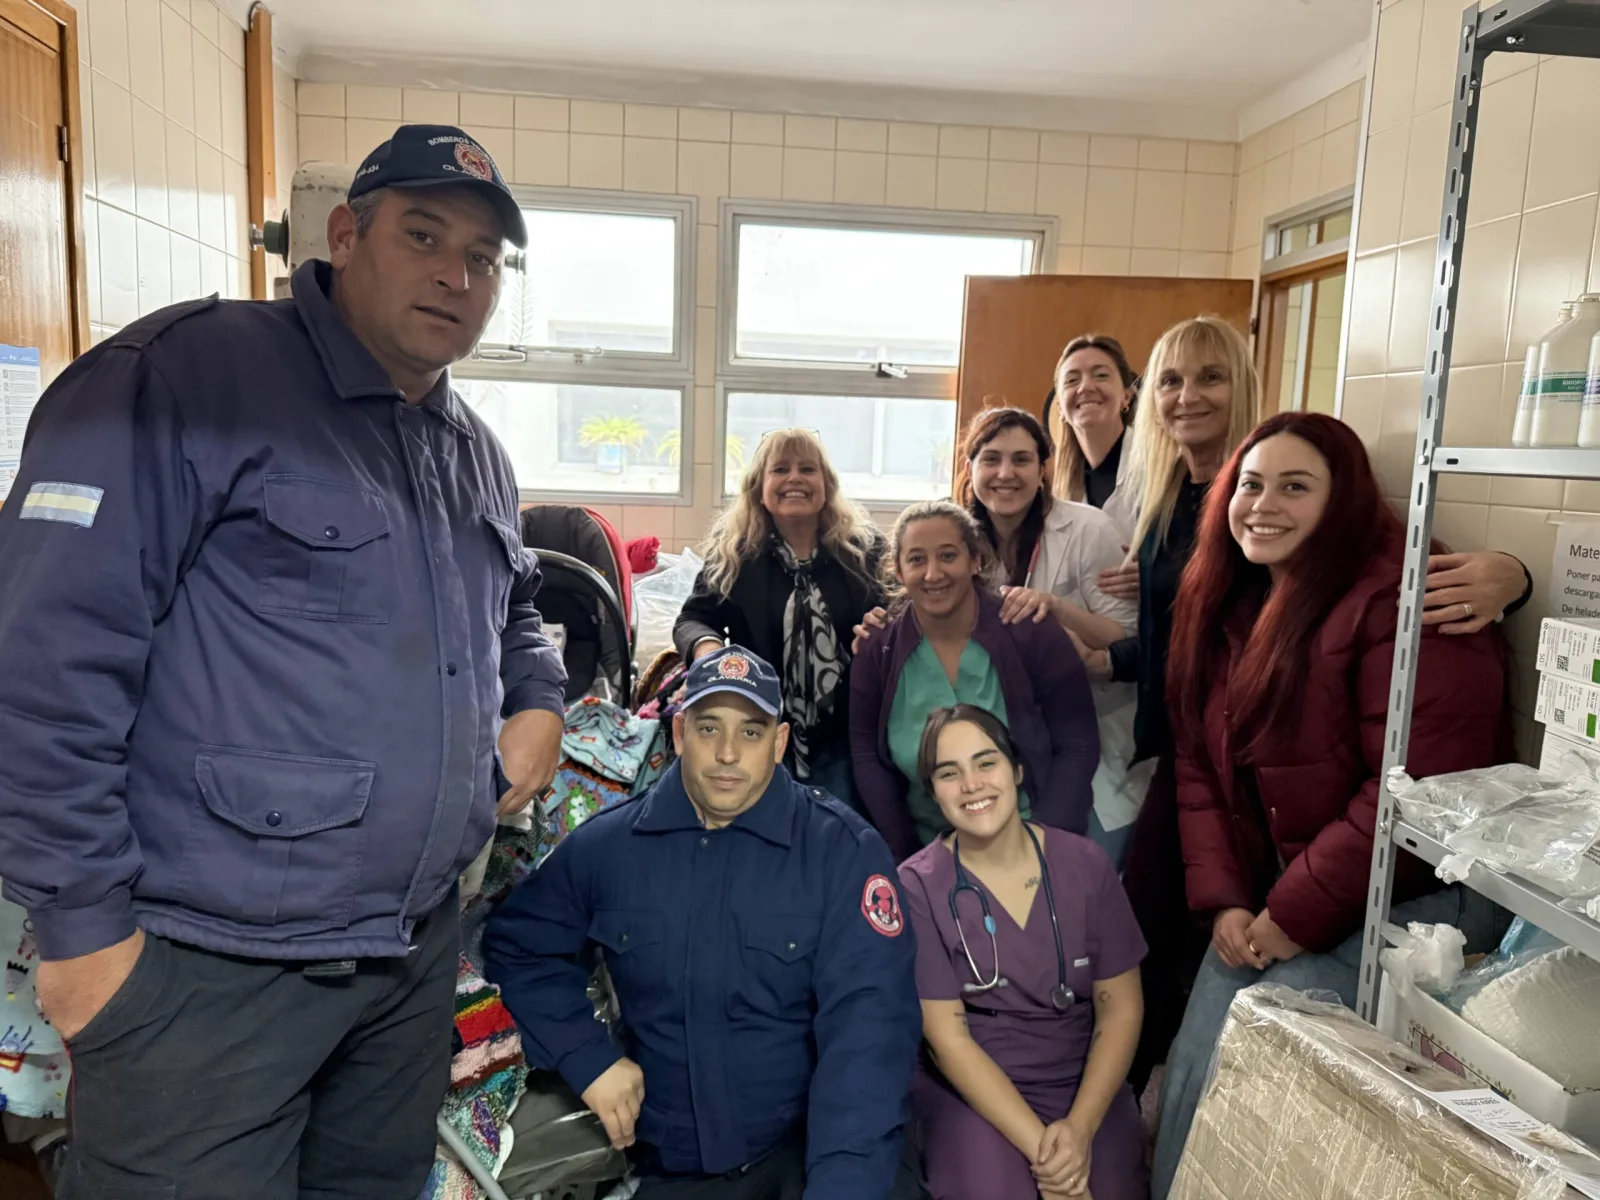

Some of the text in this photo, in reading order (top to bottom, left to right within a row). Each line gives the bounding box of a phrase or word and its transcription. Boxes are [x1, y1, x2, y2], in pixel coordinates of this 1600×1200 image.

[427, 135, 470, 146] BOMBEROS
[1569, 544, 1600, 560] Mate
[1566, 569, 1590, 581] Poner
[1561, 603, 1574, 614] De
